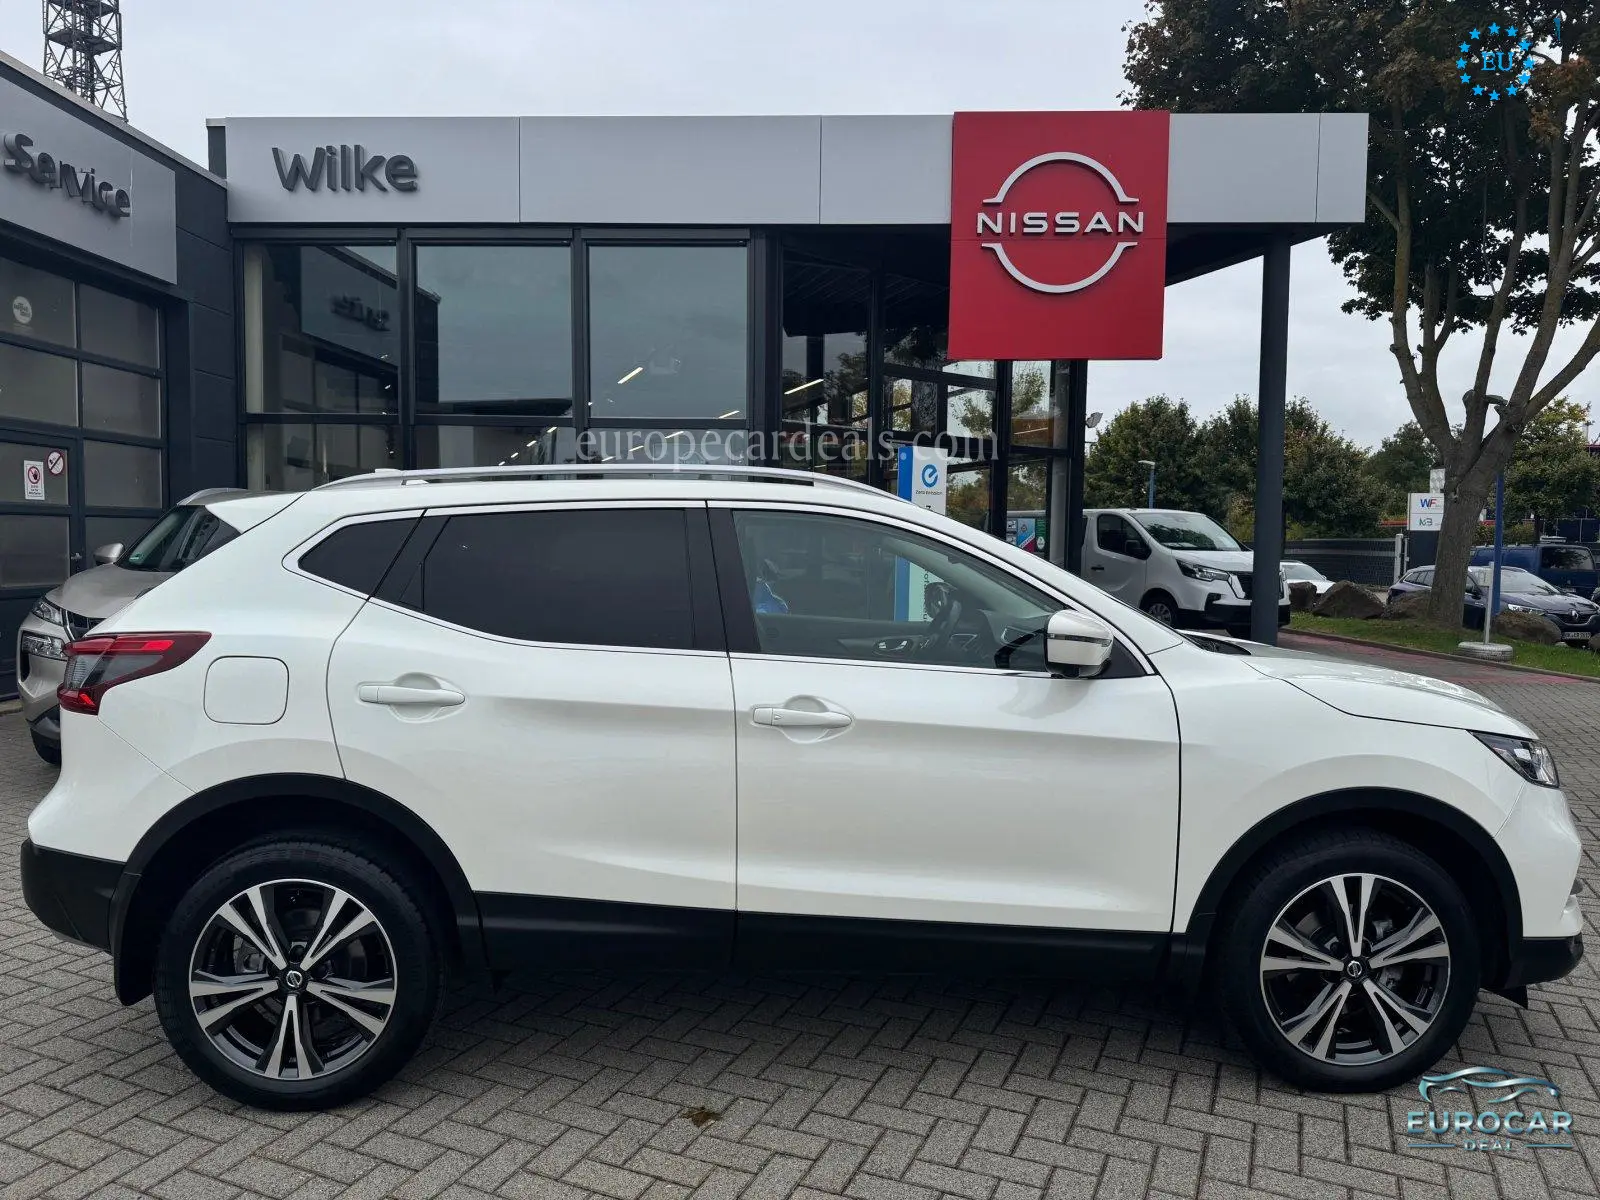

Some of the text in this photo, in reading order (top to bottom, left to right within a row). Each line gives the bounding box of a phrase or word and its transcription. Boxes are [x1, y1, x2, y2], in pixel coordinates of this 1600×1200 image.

[3, 133, 131, 217] Service
[272, 144, 418, 192] Wilke
[976, 211, 1144, 234] NISSAN
